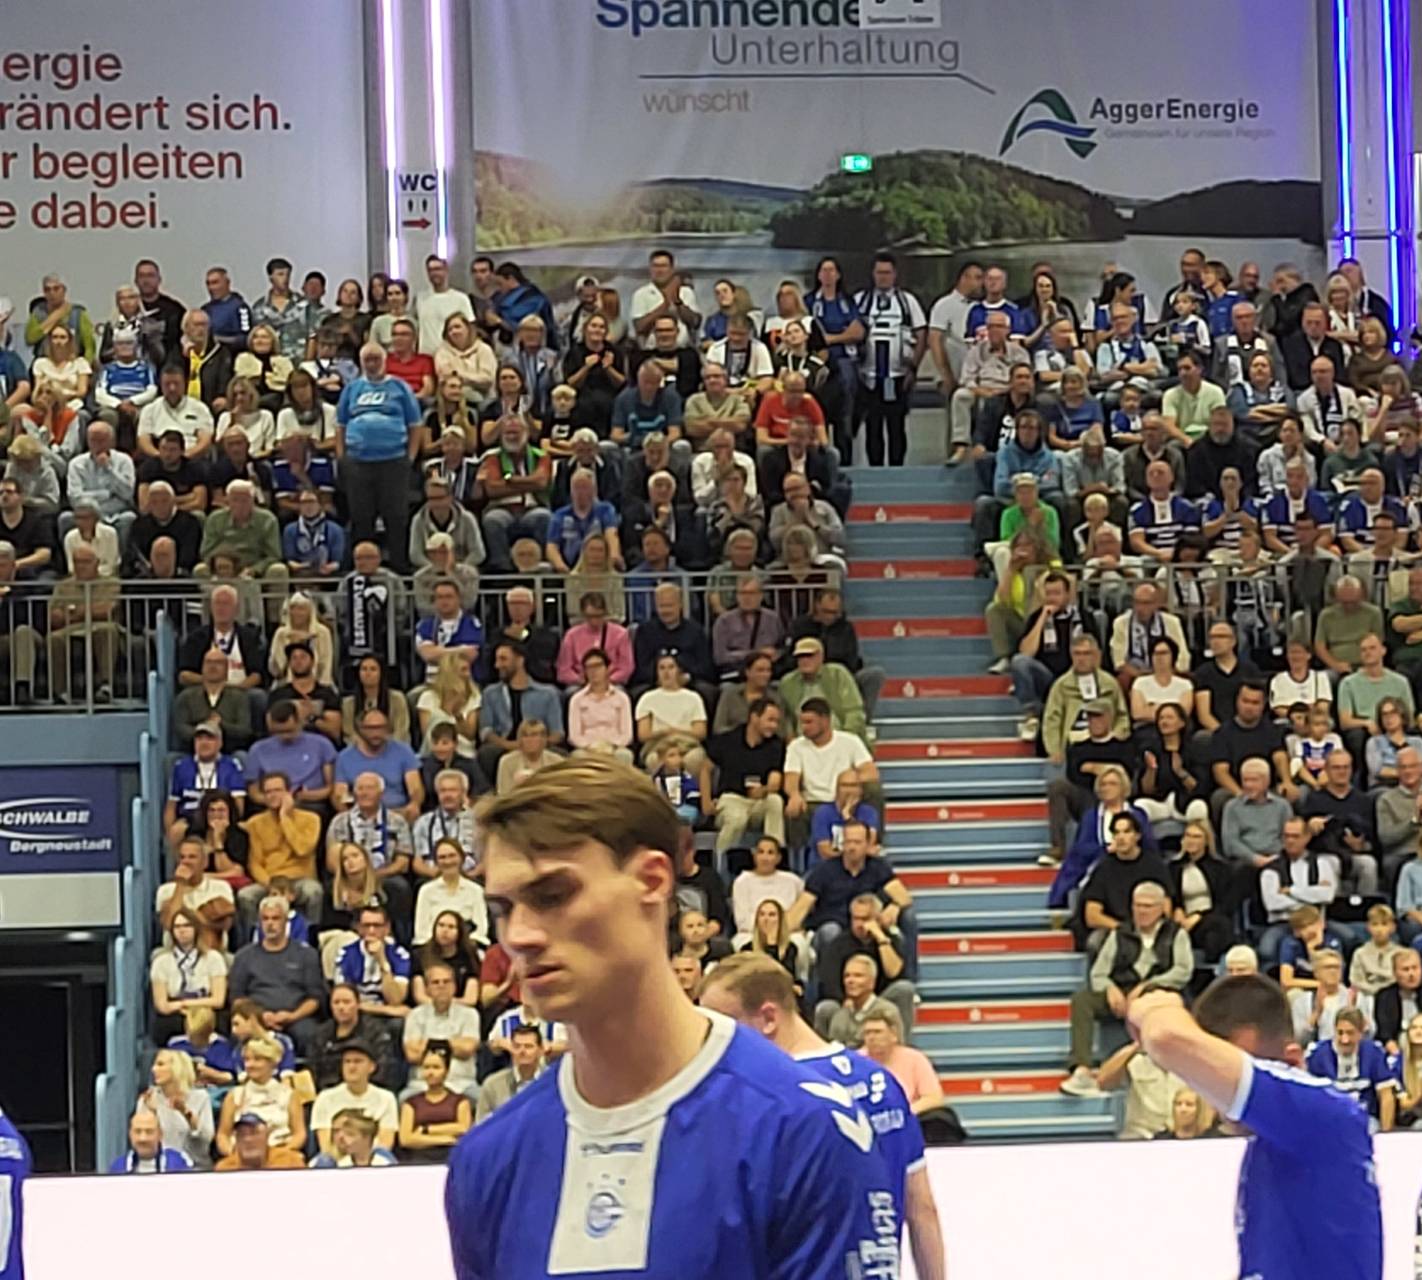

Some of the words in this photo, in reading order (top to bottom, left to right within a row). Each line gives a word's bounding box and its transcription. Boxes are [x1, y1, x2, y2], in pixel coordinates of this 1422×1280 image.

[2, 44, 122, 90] ergie
[711, 32, 960, 71] Unterhaltung
[185, 93, 292, 131] sich.
[643, 88, 751, 114] wünscht
[1090, 97, 1260, 124] AggerEnergie
[33, 142, 243, 188] begleiten
[399, 174, 437, 191] WC
[31, 192, 169, 230] dabei.
[0, 810, 90, 825] CHWALBE
